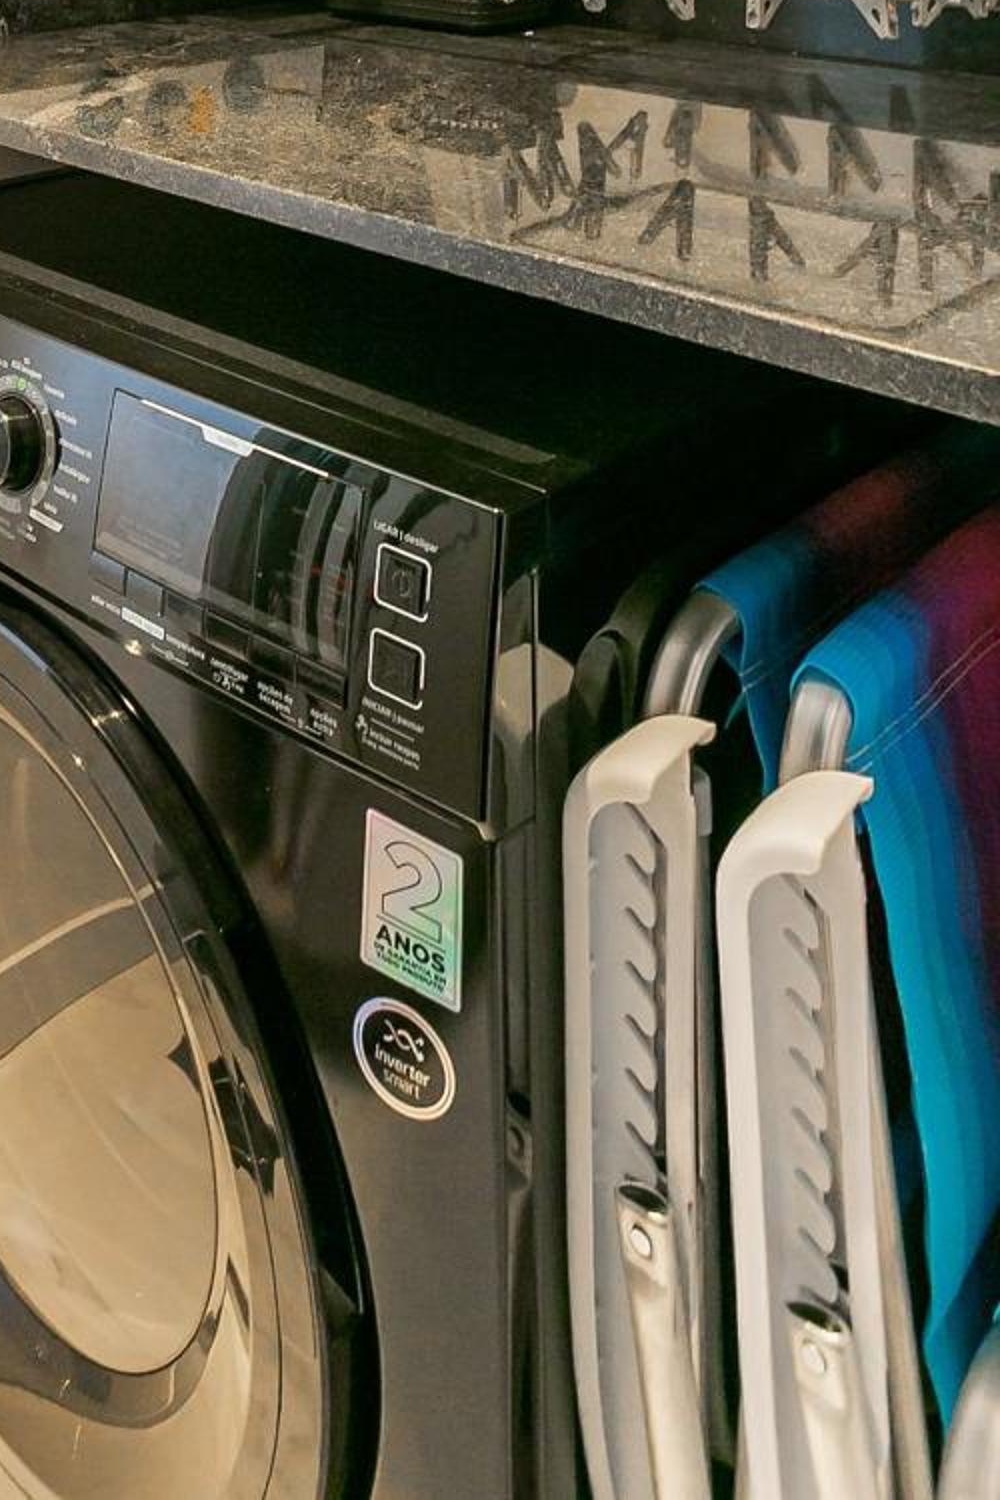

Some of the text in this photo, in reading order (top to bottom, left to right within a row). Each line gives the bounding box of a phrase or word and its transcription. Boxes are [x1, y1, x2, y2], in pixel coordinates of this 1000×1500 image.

[382, 840, 442, 944] 2
[376, 924, 445, 973] ANOS
[375, 1043, 430, 1087] inverter
[384, 1068, 420, 1100] smart
